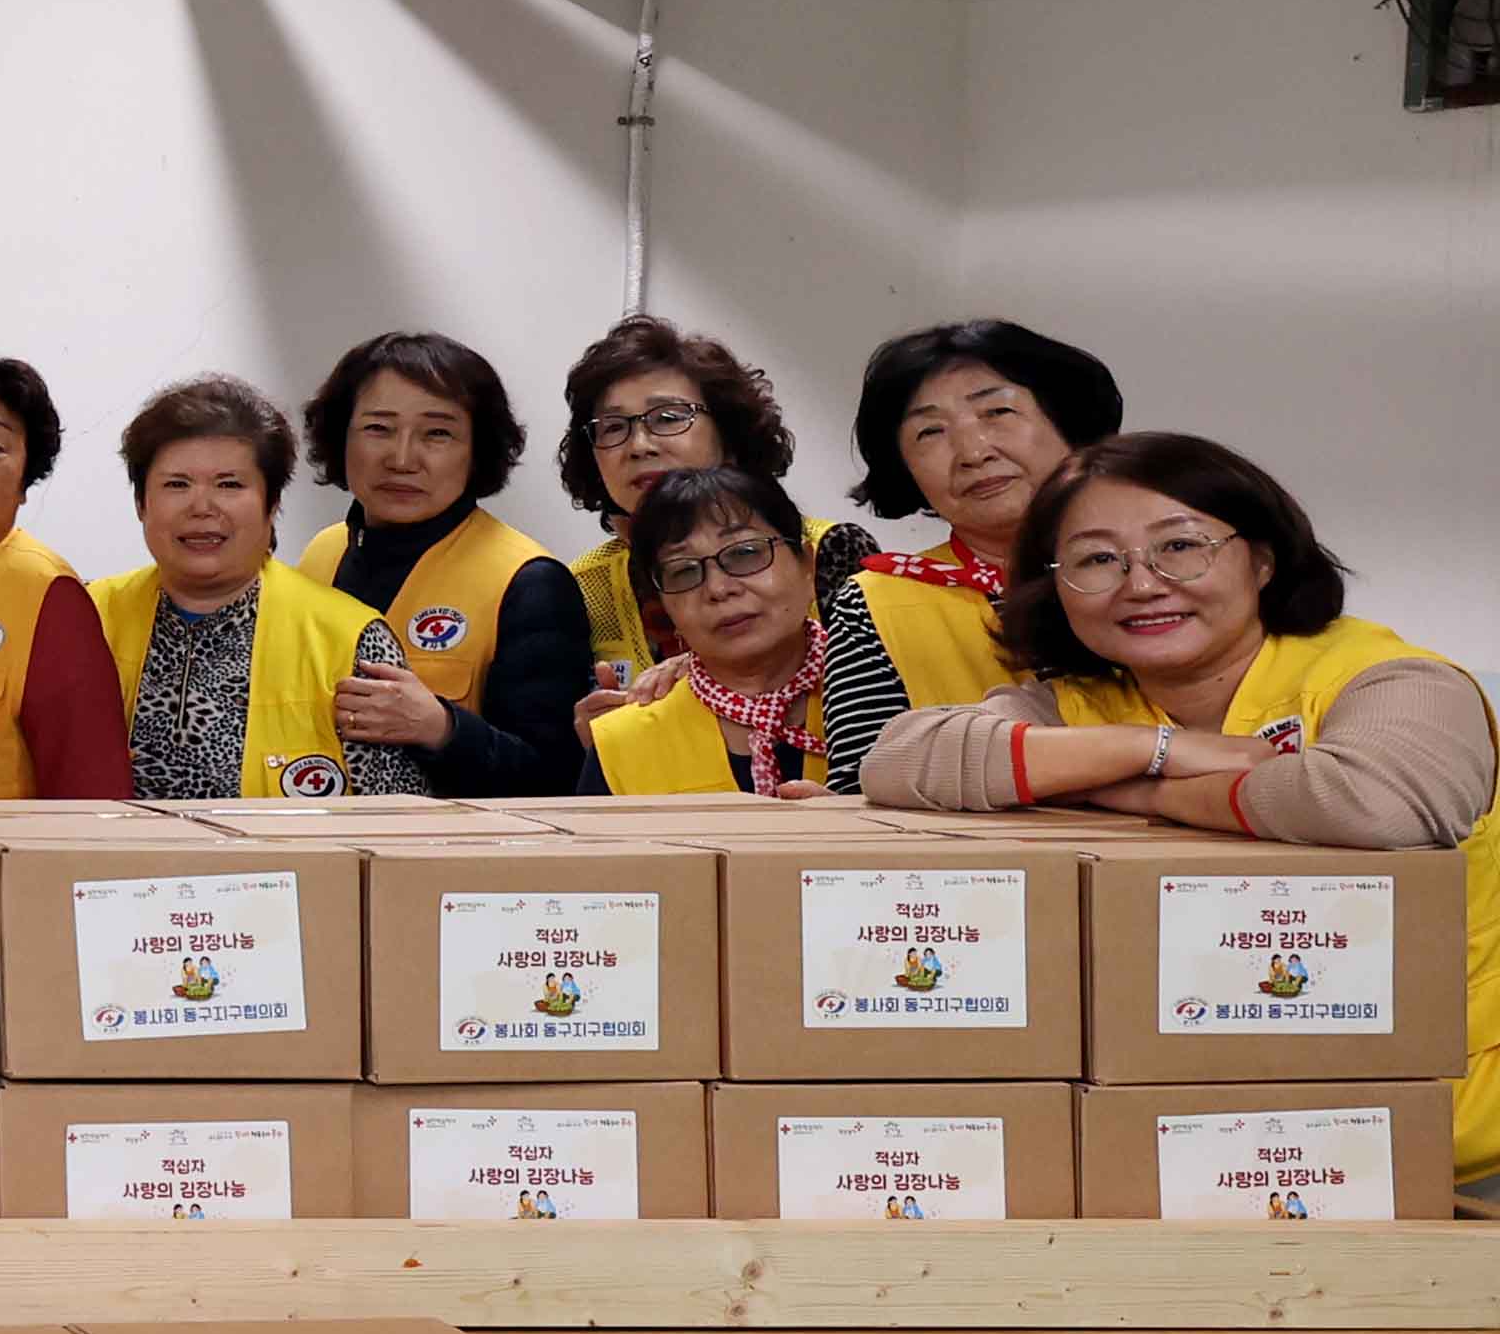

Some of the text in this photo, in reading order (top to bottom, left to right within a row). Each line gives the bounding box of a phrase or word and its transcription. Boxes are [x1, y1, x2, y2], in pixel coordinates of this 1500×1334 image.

[1261, 909, 1309, 926] 적십자
[1219, 931, 1349, 951] 사랑의 김장나눔
